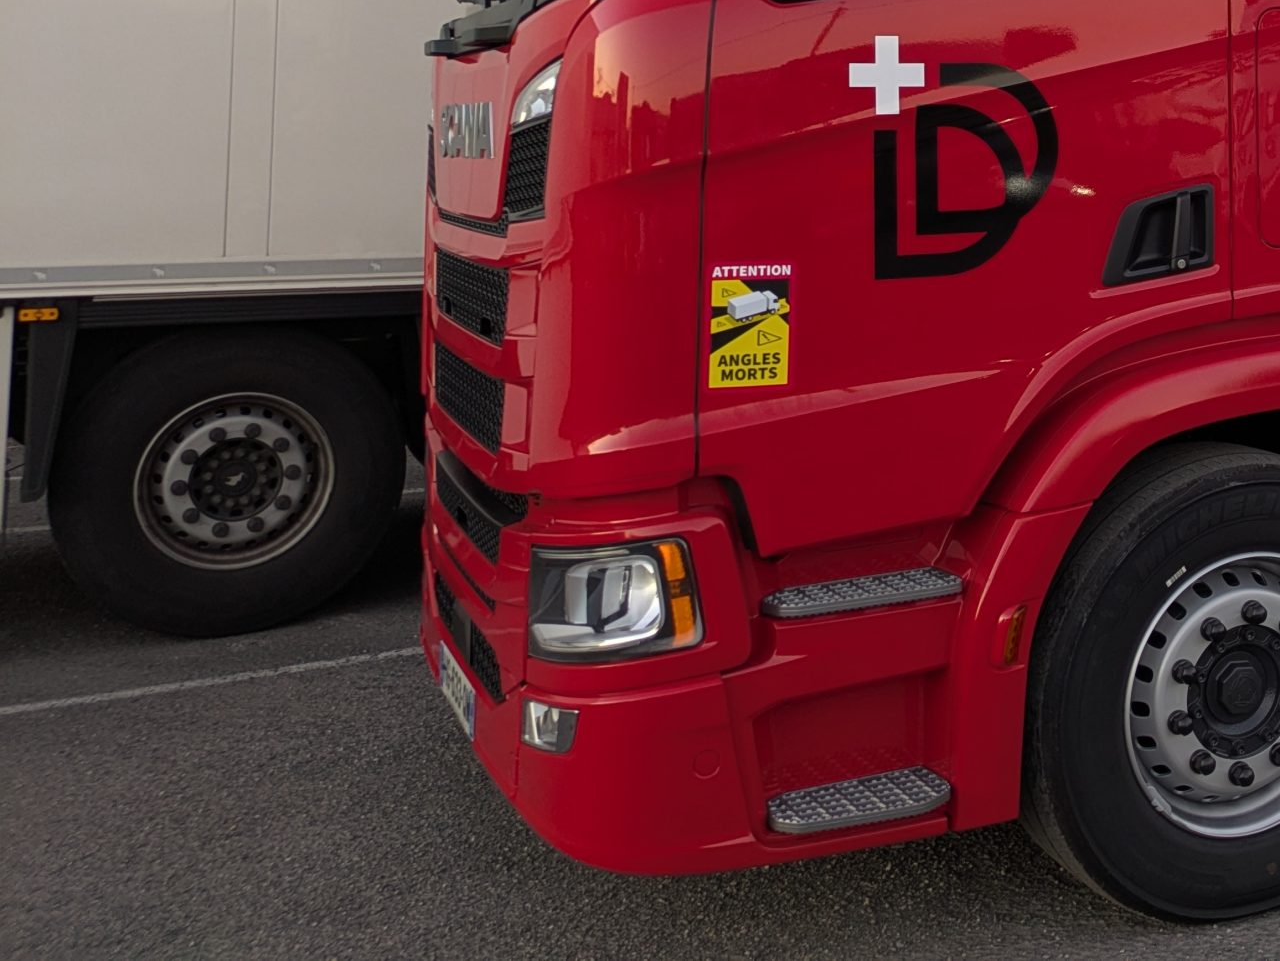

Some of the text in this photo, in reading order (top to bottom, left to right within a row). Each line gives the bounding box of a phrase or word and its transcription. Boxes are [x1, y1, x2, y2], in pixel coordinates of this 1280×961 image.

[440, 101, 494, 159] SCANIA
[712, 265, 791, 278] ATTENTION
[717, 352, 781, 367] ANGLES
[721, 367, 778, 382] MORTS
